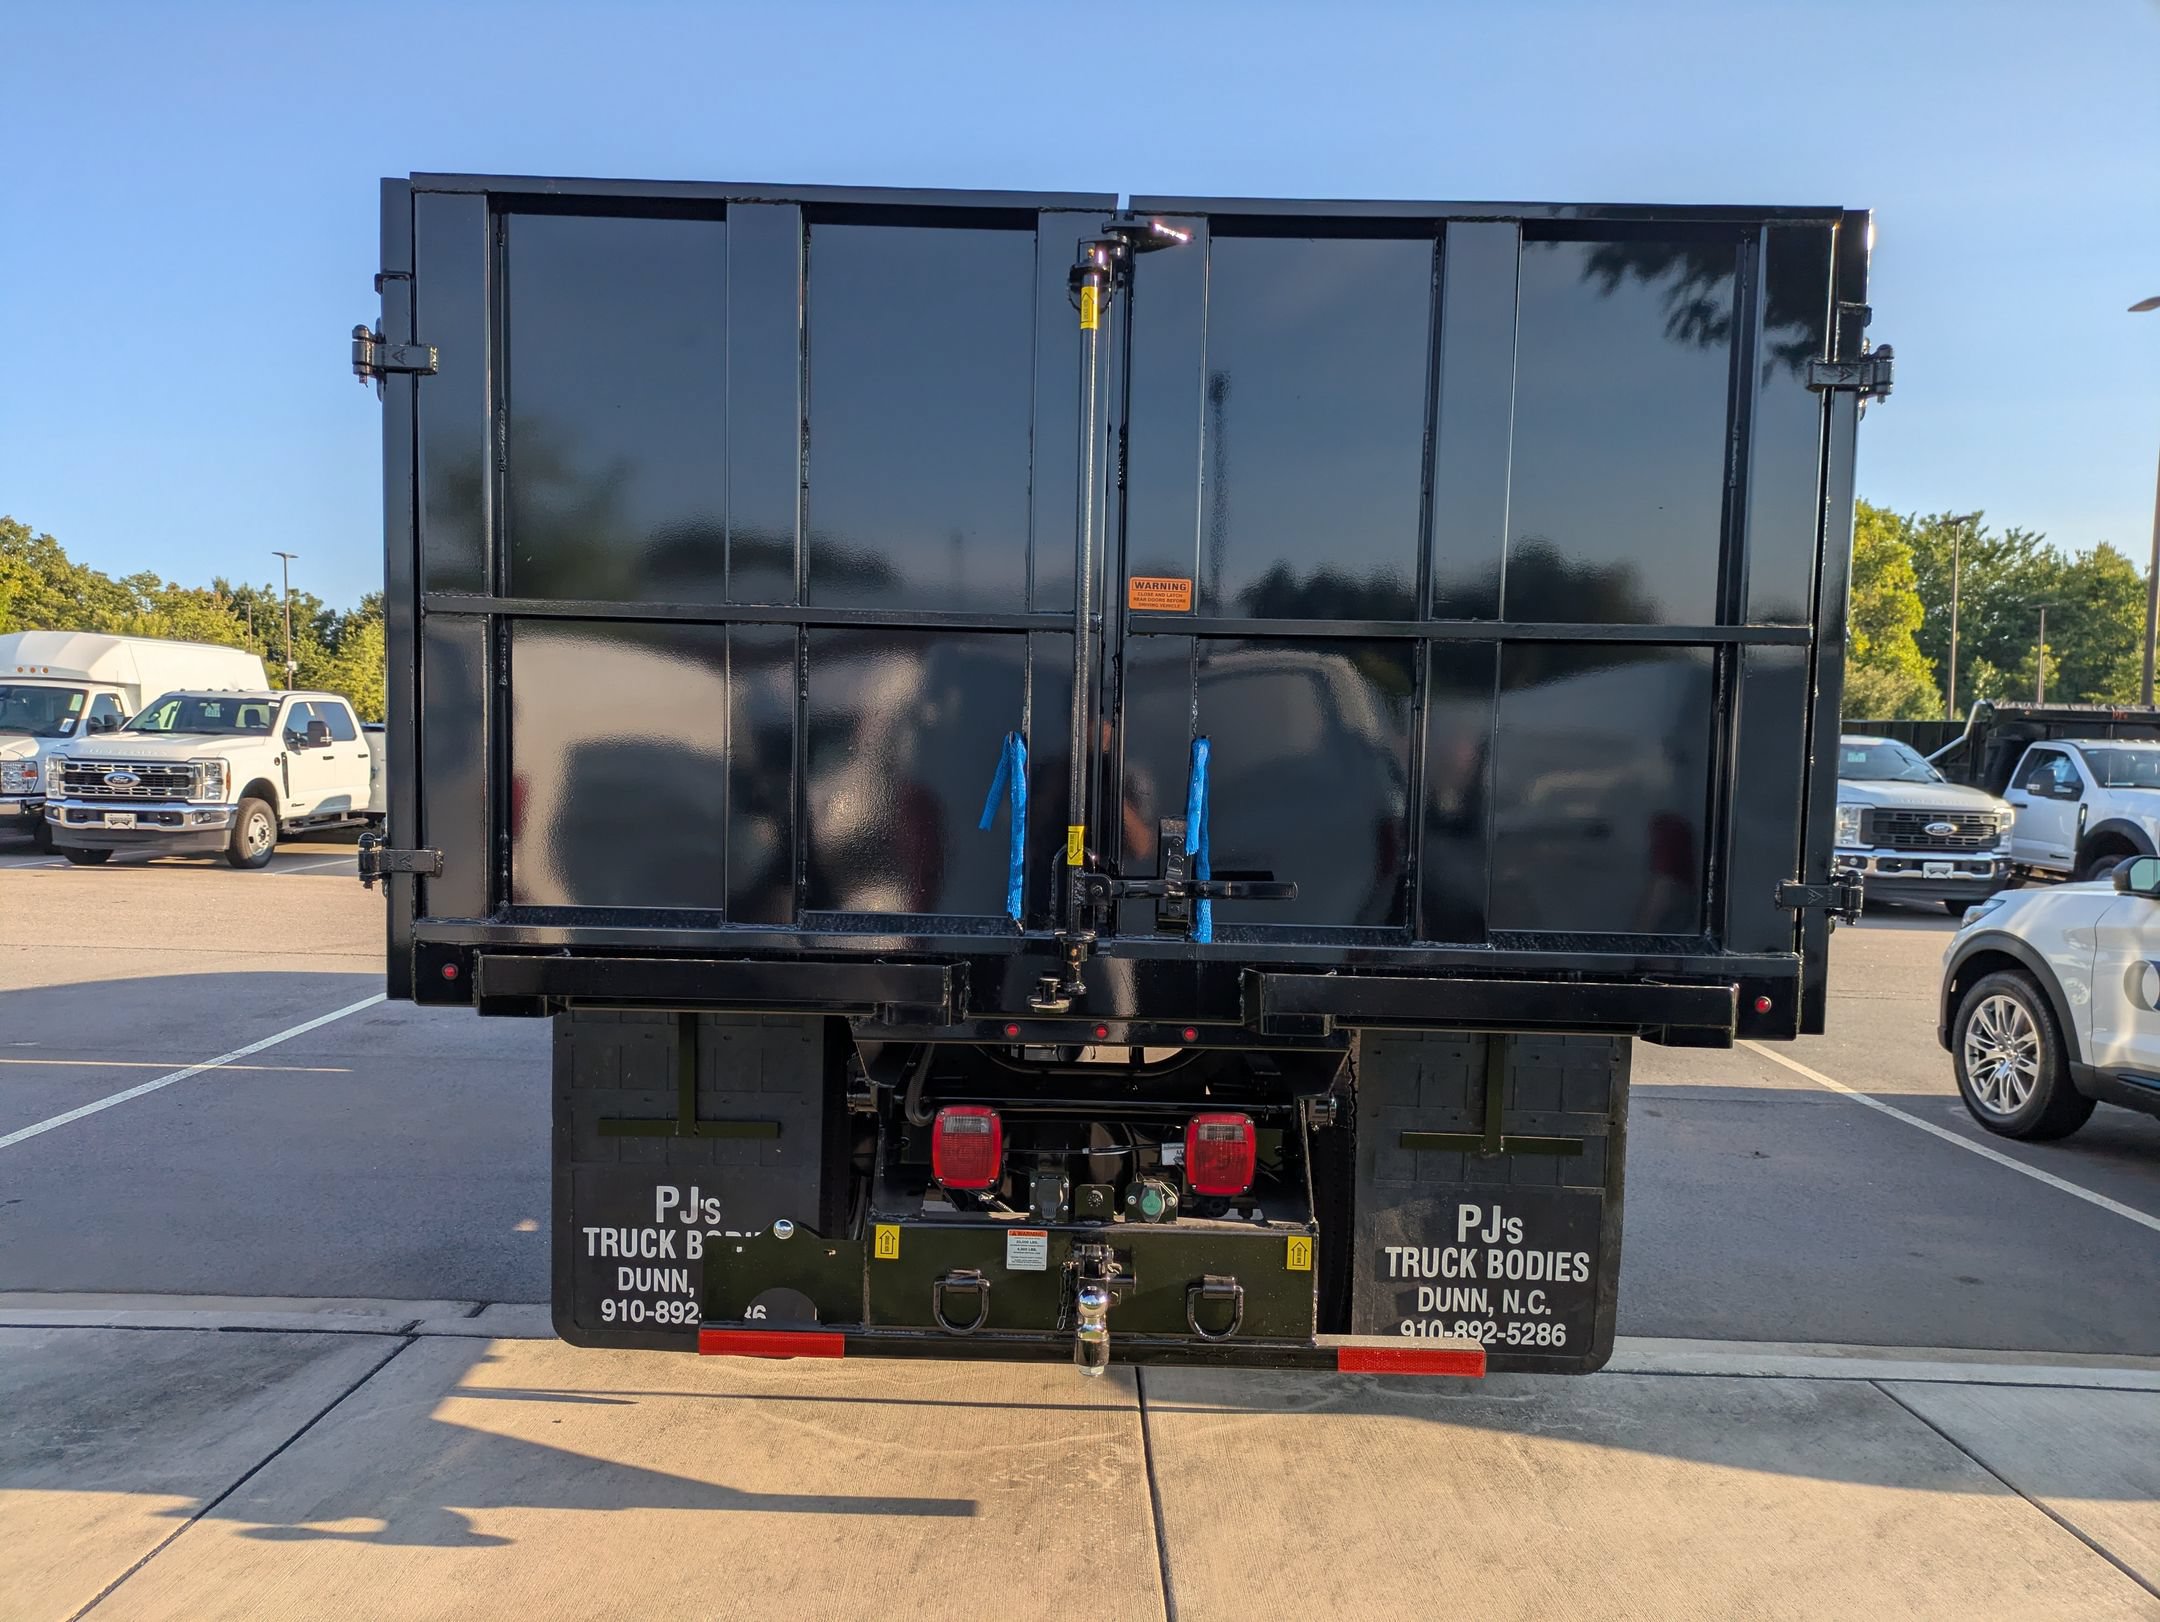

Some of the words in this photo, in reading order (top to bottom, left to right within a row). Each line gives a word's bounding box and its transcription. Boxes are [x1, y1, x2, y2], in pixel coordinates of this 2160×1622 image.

[1135, 582, 1187, 590] WARNING
[656, 1185, 721, 1225] PJ's
[1457, 1204, 1524, 1245] PJ's
[582, 1227, 677, 1259] TRUCK
[1385, 1246, 1478, 1280] TRUCK
[1487, 1248, 1590, 1283] BODIES
[617, 1267, 695, 1298] DUNN,
[1418, 1286, 1494, 1318] DUNN,
[1502, 1289, 1552, 1315] N.C.
[1400, 1319, 1567, 1347] 910-892-5286
